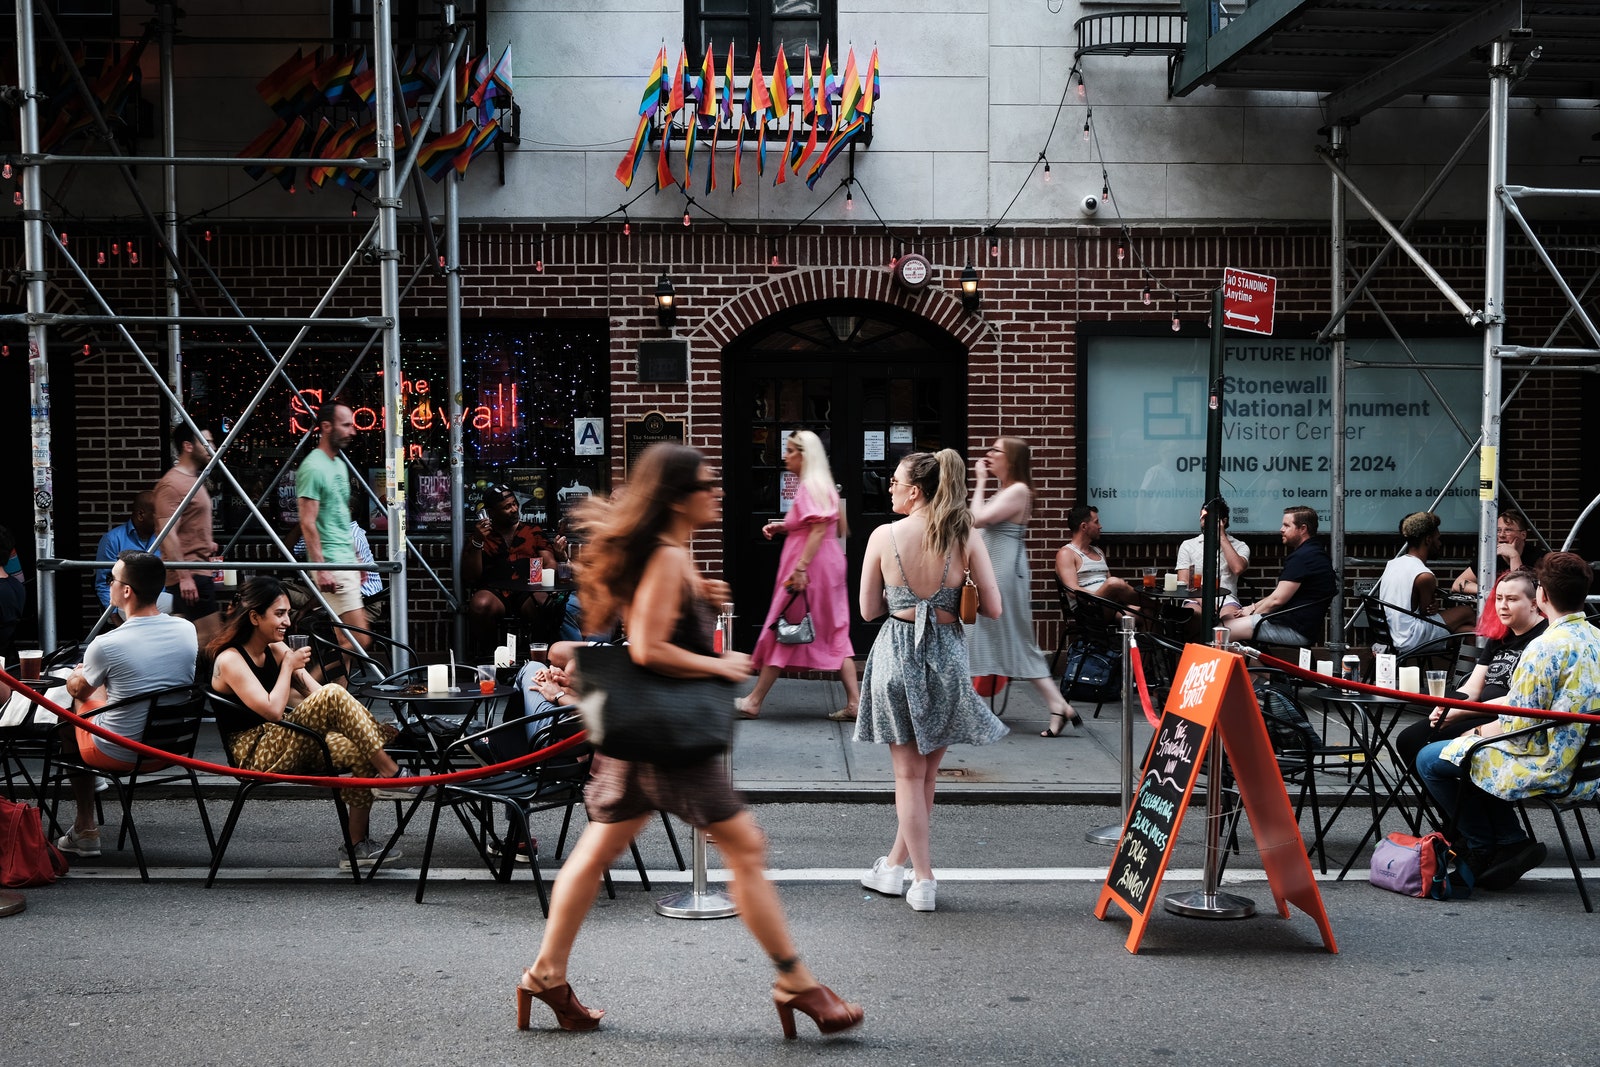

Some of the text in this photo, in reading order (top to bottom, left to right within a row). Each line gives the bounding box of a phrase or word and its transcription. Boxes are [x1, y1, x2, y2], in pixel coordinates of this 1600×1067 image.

[1227, 275, 1268, 292] NO STANDING
[1226, 288, 1253, 302] Anytime
[1225, 347, 1295, 361] FUTURE
[376, 371, 430, 393] he
[1223, 375, 1327, 395] Stonewall
[290, 383, 518, 435] Soewall
[1222, 398, 1431, 417] National Mnument
[580, 422, 600, 445] A
[1222, 421, 1366, 440] Visitor Cener
[1263, 456, 1313, 472] JUNE
[1350, 455, 1396, 472] 2024
[1089, 487, 1118, 499] Visit
[1119, 487, 1280, 501] stonewallvisitenter.org
[1282, 487, 1295, 498] to
[1298, 487, 1328, 498] learn
[1342, 488, 1362, 498] ore
[1364, 488, 1378, 498] or
[1380, 486, 1413, 498] make
[1415, 488, 1423, 498] a
[1179, 658, 1221, 695] APEROL
[1174, 719, 1189, 740] THE
[1156, 728, 1192, 764] STONEWALL
[1140, 791, 1175, 823] CELEBRATING
[1130, 810, 1151, 836] BLACK
[1148, 823, 1168, 852] VOICES
[1127, 839, 1149, 870] DRAG
[1115, 863, 1150, 903] BINGO!
